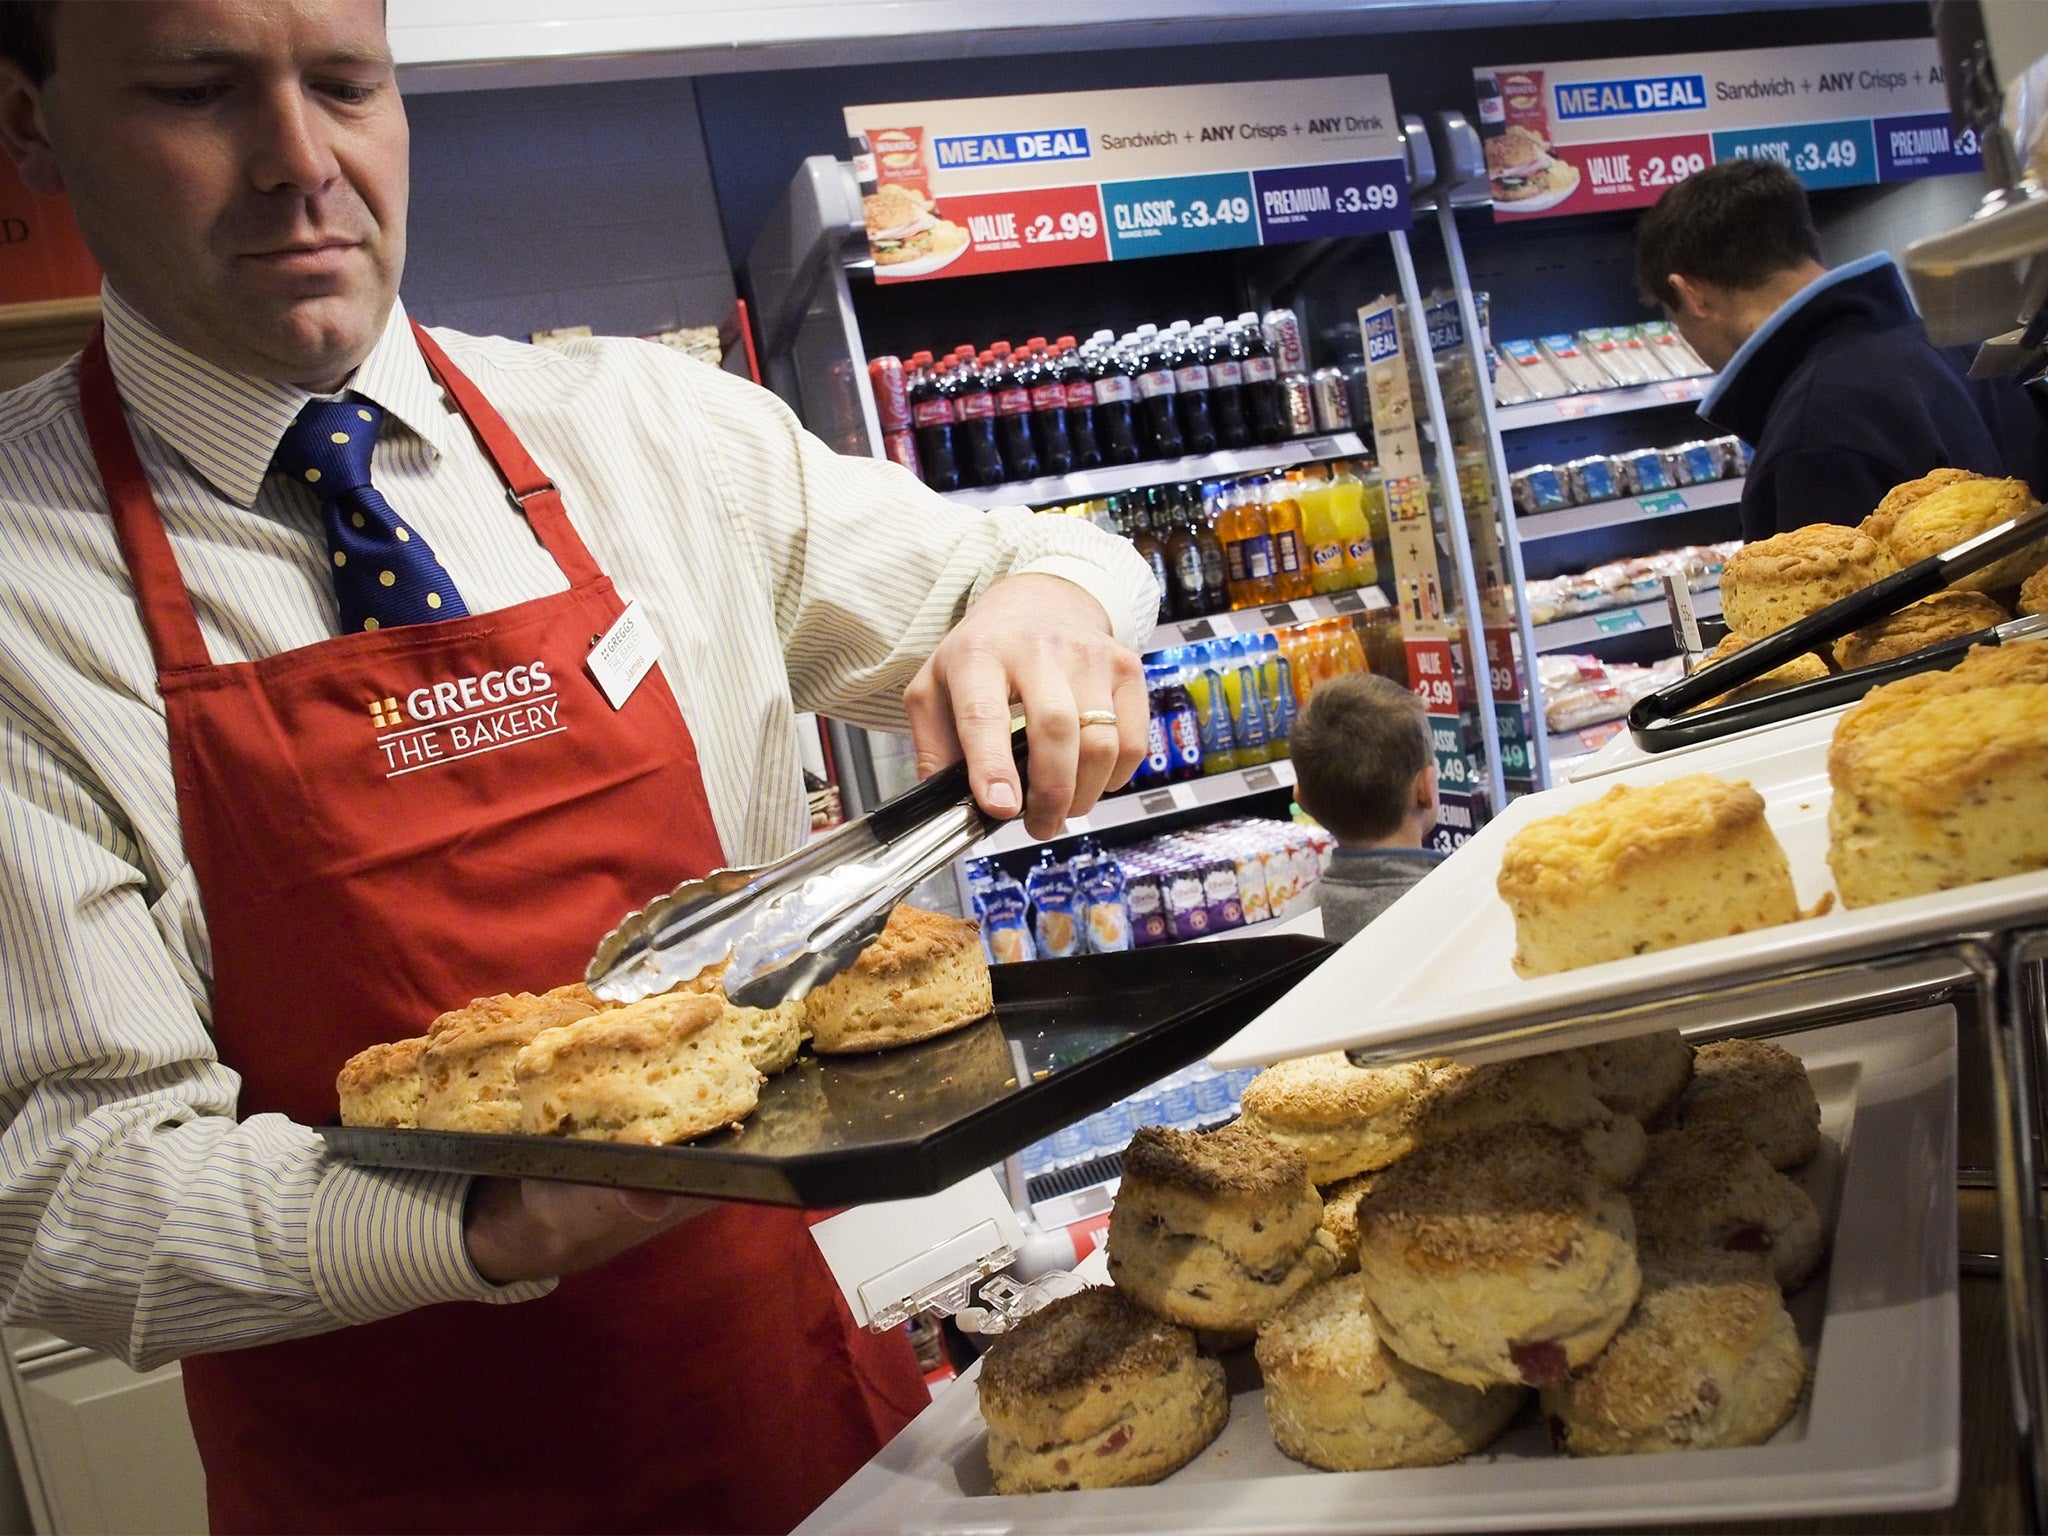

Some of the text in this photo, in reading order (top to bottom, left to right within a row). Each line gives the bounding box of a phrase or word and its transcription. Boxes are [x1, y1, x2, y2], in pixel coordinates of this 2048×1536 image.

[1558, 79, 1703, 115] MEAL DEAL
[1715, 76, 1796, 101] Sandwich
[1818, 72, 1855, 93] ANY
[1858, 68, 1908, 91] Crisps
[937, 132, 1088, 165] MEAL DEAL
[1101, 126, 1179, 150] Sandwich
[1200, 126, 1236, 143] ANY
[1239, 123, 1287, 142] Crisps
[1307, 117, 1342, 134] ANY
[1345, 115, 1384, 132] Drink
[1889, 127, 1950, 156] PREMIUM
[1585, 154, 1633, 186] VALUE
[1794, 139, 1857, 172] £3.49
[1114, 197, 1250, 231] CLASSIC £3.49
[1263, 183, 1398, 217] PREMIUM £3.99
[967, 210, 1098, 244] VALUE £2.99
[1367, 317, 1394, 338] MEAL
[1369, 331, 1397, 359] DEAL
[607, 616, 634, 653] GREGGS
[406, 660, 553, 722] GREGGS
[378, 700, 561, 769] THE BAKERY
